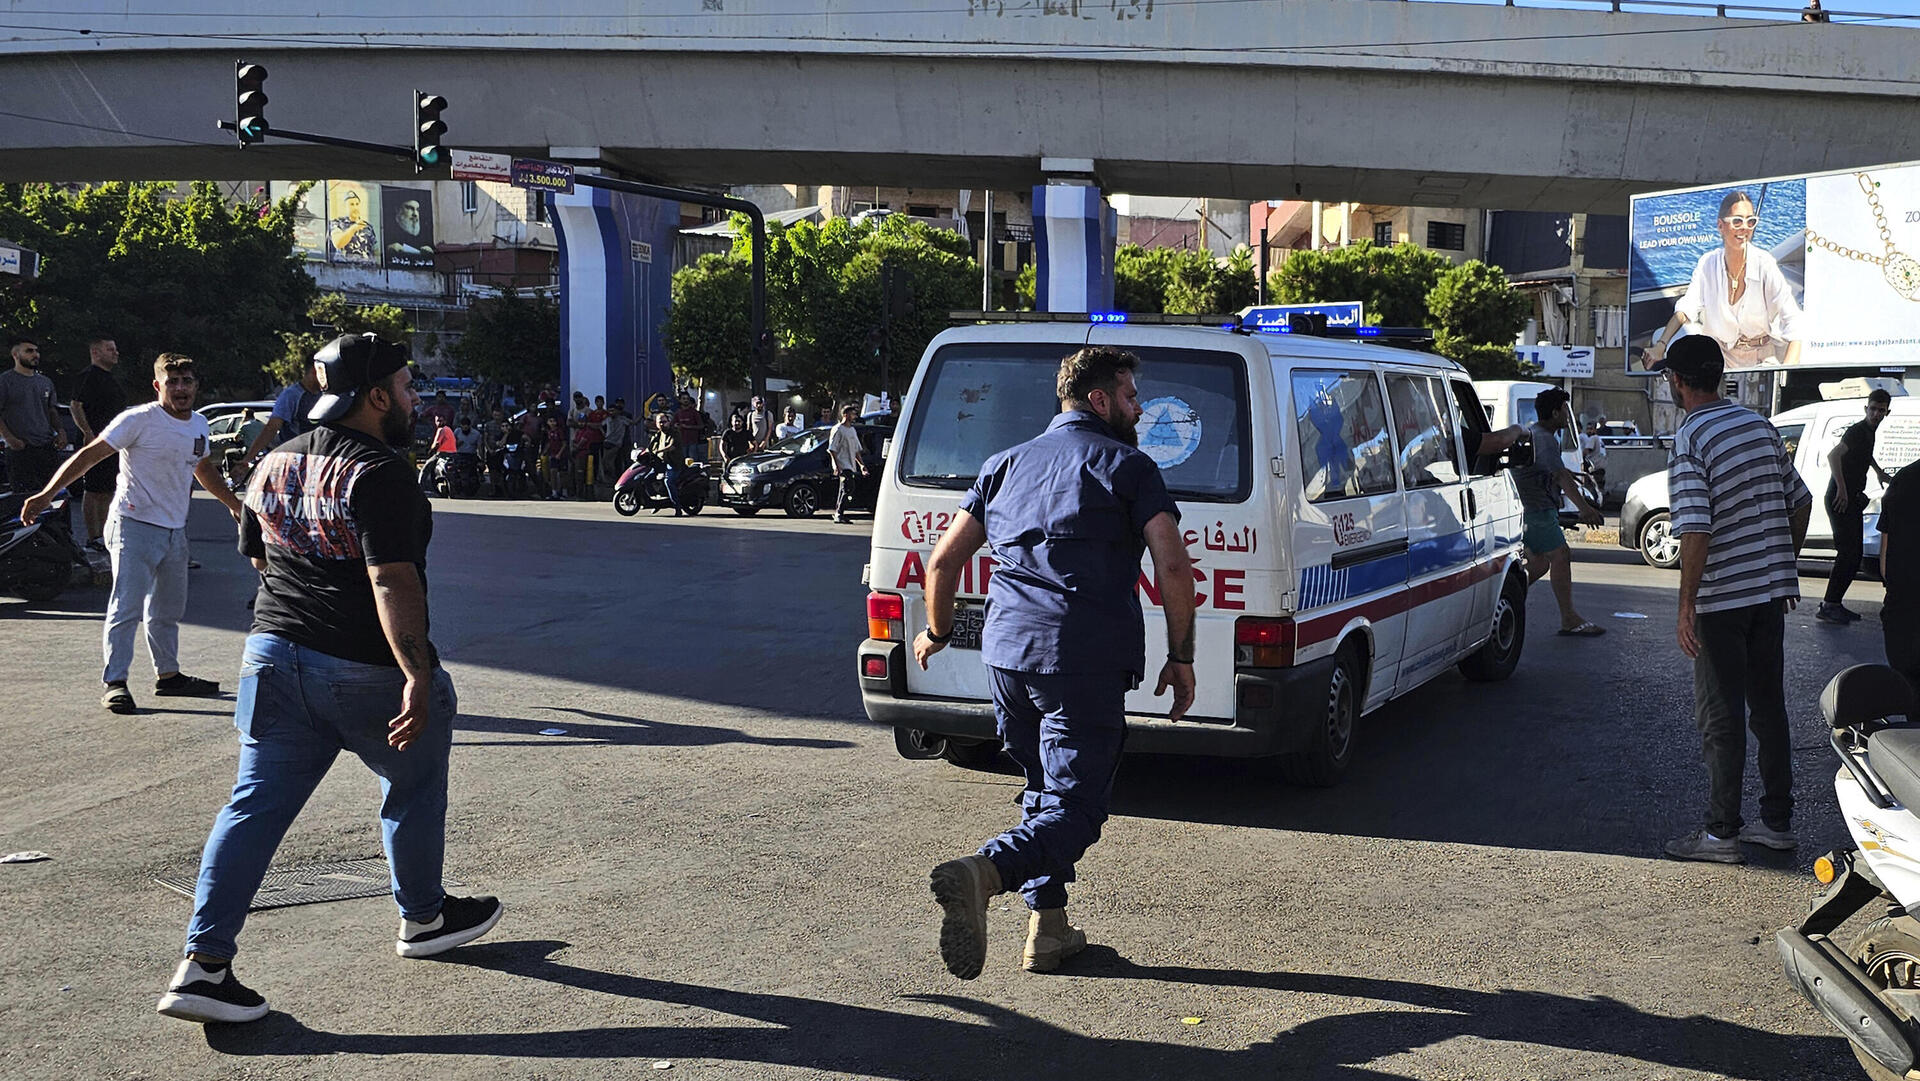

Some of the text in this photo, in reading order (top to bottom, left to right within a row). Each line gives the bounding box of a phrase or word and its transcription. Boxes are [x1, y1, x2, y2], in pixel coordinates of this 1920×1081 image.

[528, 174, 567, 188] 3.500.000
[1653, 212, 1701, 226] BOUSSOLE
[1656, 223, 1697, 233] COLLECTION
[1640, 234, 1715, 249] LEAD YOUR OWN WAY
[1810, 340, 1825, 348] Shop
[922, 511, 957, 531] 12
[1339, 512, 1355, 532] 125
